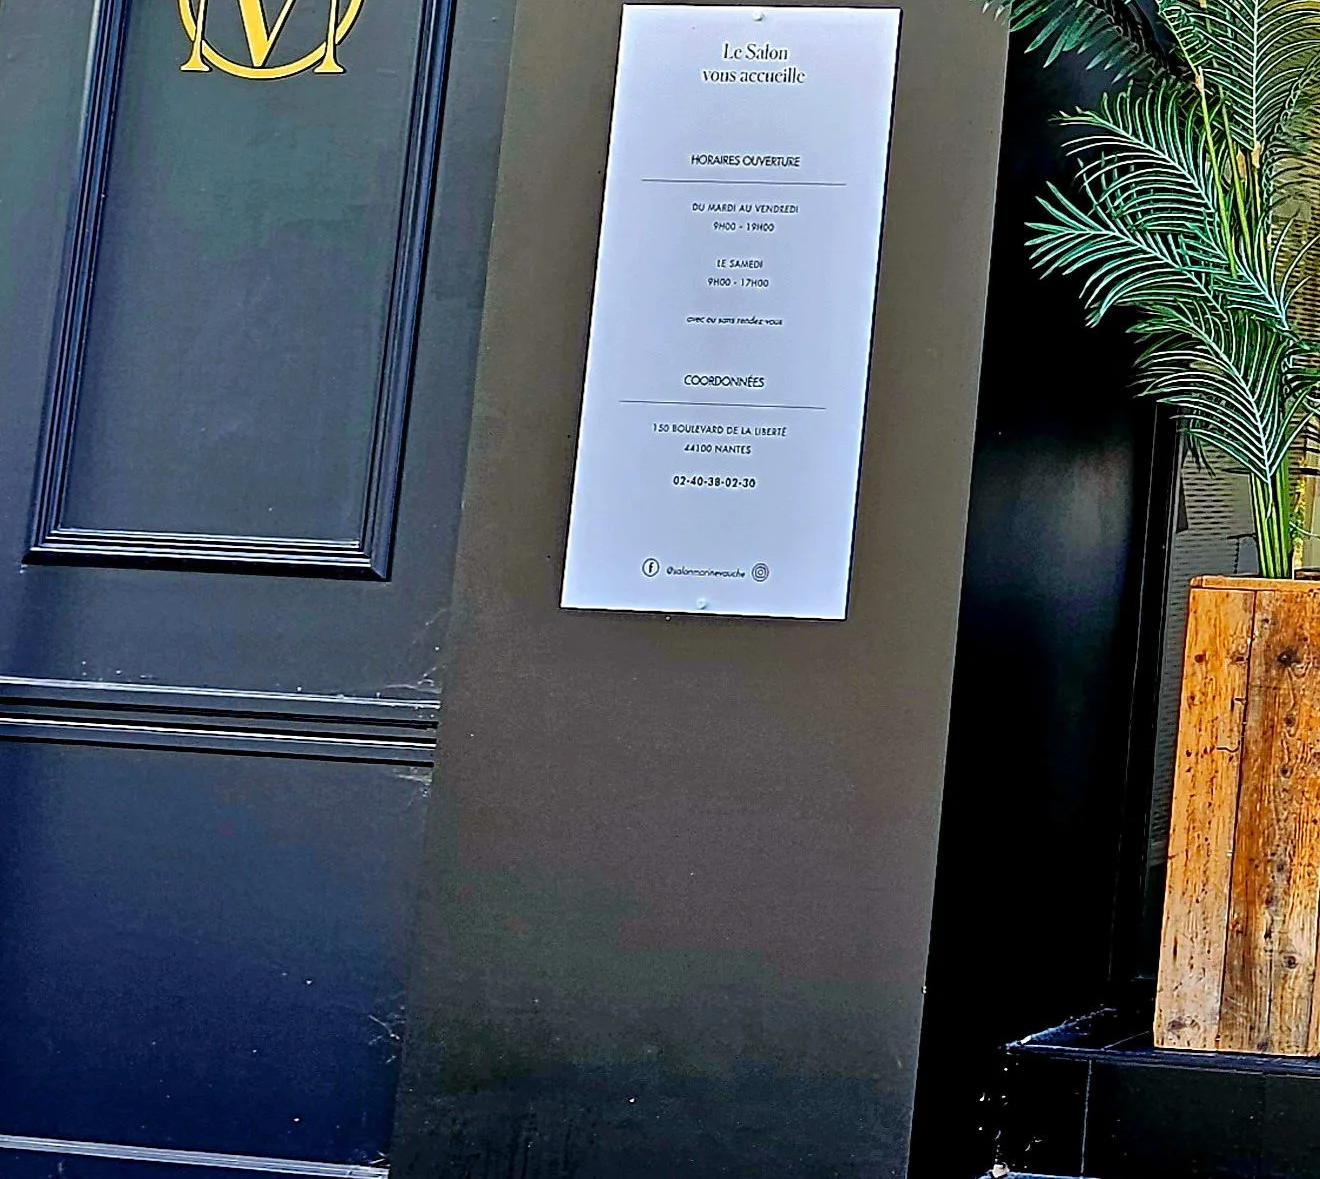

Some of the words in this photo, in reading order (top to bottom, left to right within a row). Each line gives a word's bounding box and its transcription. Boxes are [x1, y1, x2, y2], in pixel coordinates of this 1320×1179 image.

[724, 44, 742, 59] Le
[745, 44, 787, 60] Salon
[703, 71, 736, 82] vous
[740, 68, 805, 83] accueille
[691, 155, 740, 165] HORAIRES
[742, 156, 800, 167] OUVERTURE
[693, 203, 705, 211] DU
[708, 204, 736, 212] MARDI
[755, 205, 798, 213] VENDREDI
[714, 222, 736, 230] 9H00
[747, 223, 774, 231] 19H00
[717, 259, 726, 267] LE
[729, 260, 763, 268] SAMEDI
[708, 278, 731, 286] 9H00
[742, 278, 769, 287] 17H00
[684, 374, 764, 387] COORDONNÉES
[654, 423, 669, 432] 150
[673, 425, 724, 433] BOULEVARD
[755, 425, 786, 436] LIBERTÉ
[684, 444, 712, 452] 44100
[715, 446, 751, 454] NANTES
